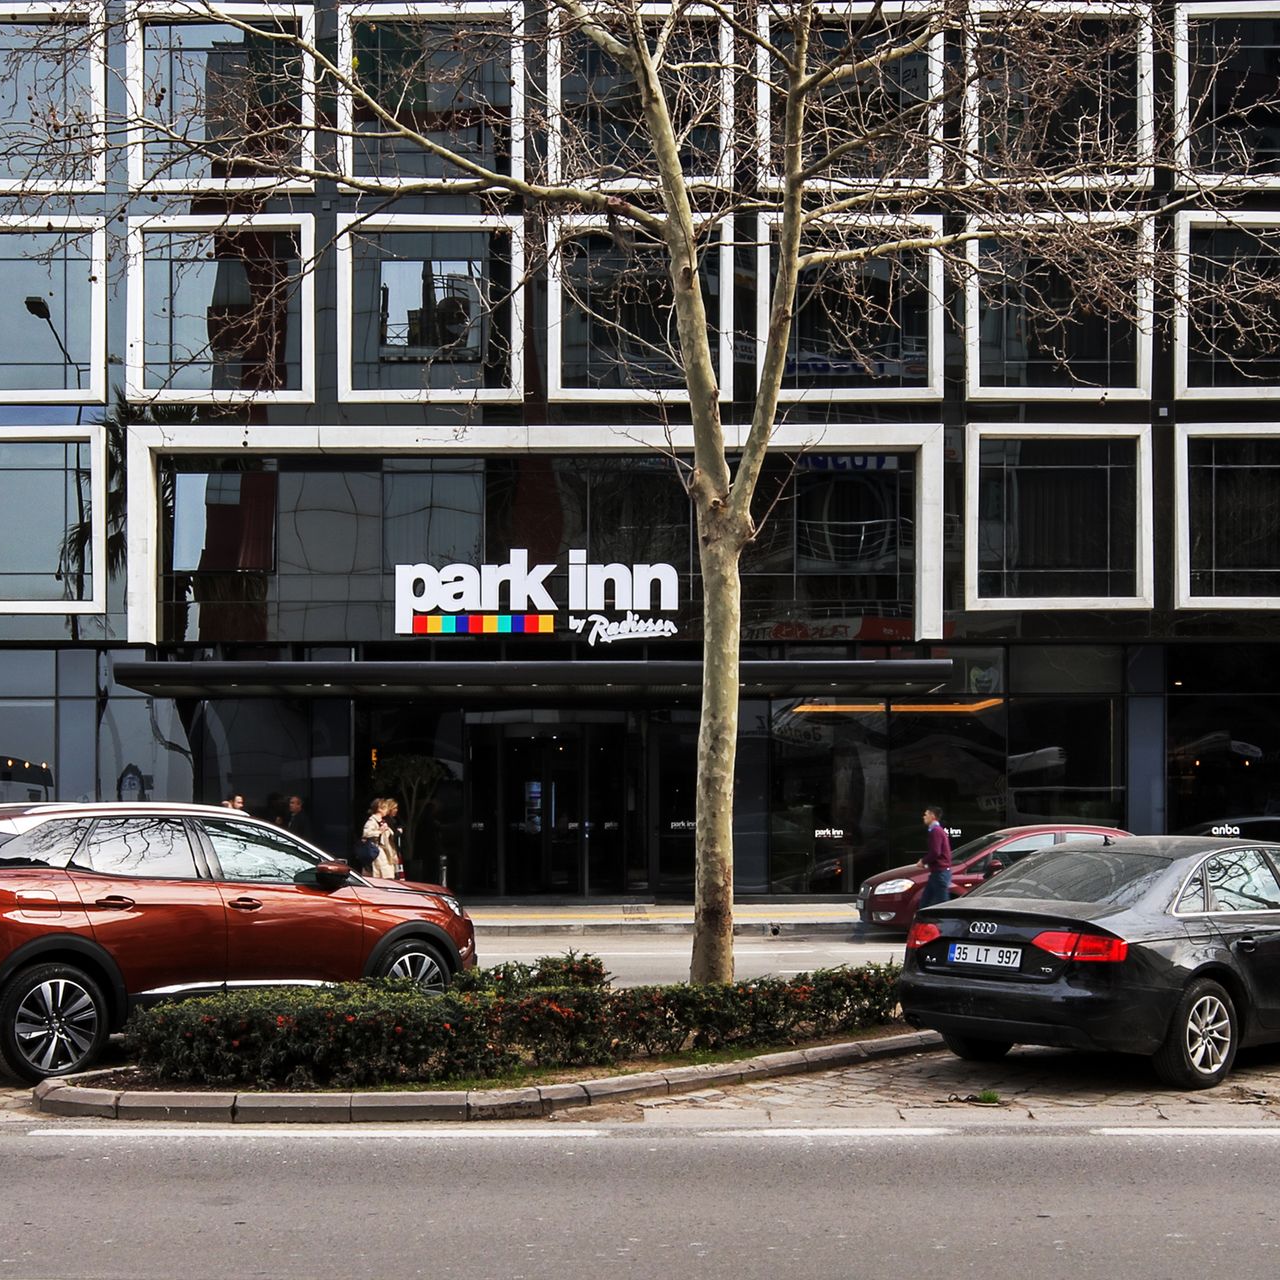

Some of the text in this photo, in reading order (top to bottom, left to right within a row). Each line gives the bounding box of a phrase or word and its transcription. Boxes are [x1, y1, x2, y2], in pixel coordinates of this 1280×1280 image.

[394, 548, 679, 635] park inn
[568, 610, 679, 647] by Radisson
[815, 828, 844, 838] park inn
[1211, 824, 1240, 836] anba
[955, 946, 1019, 966] 35 LT 997
